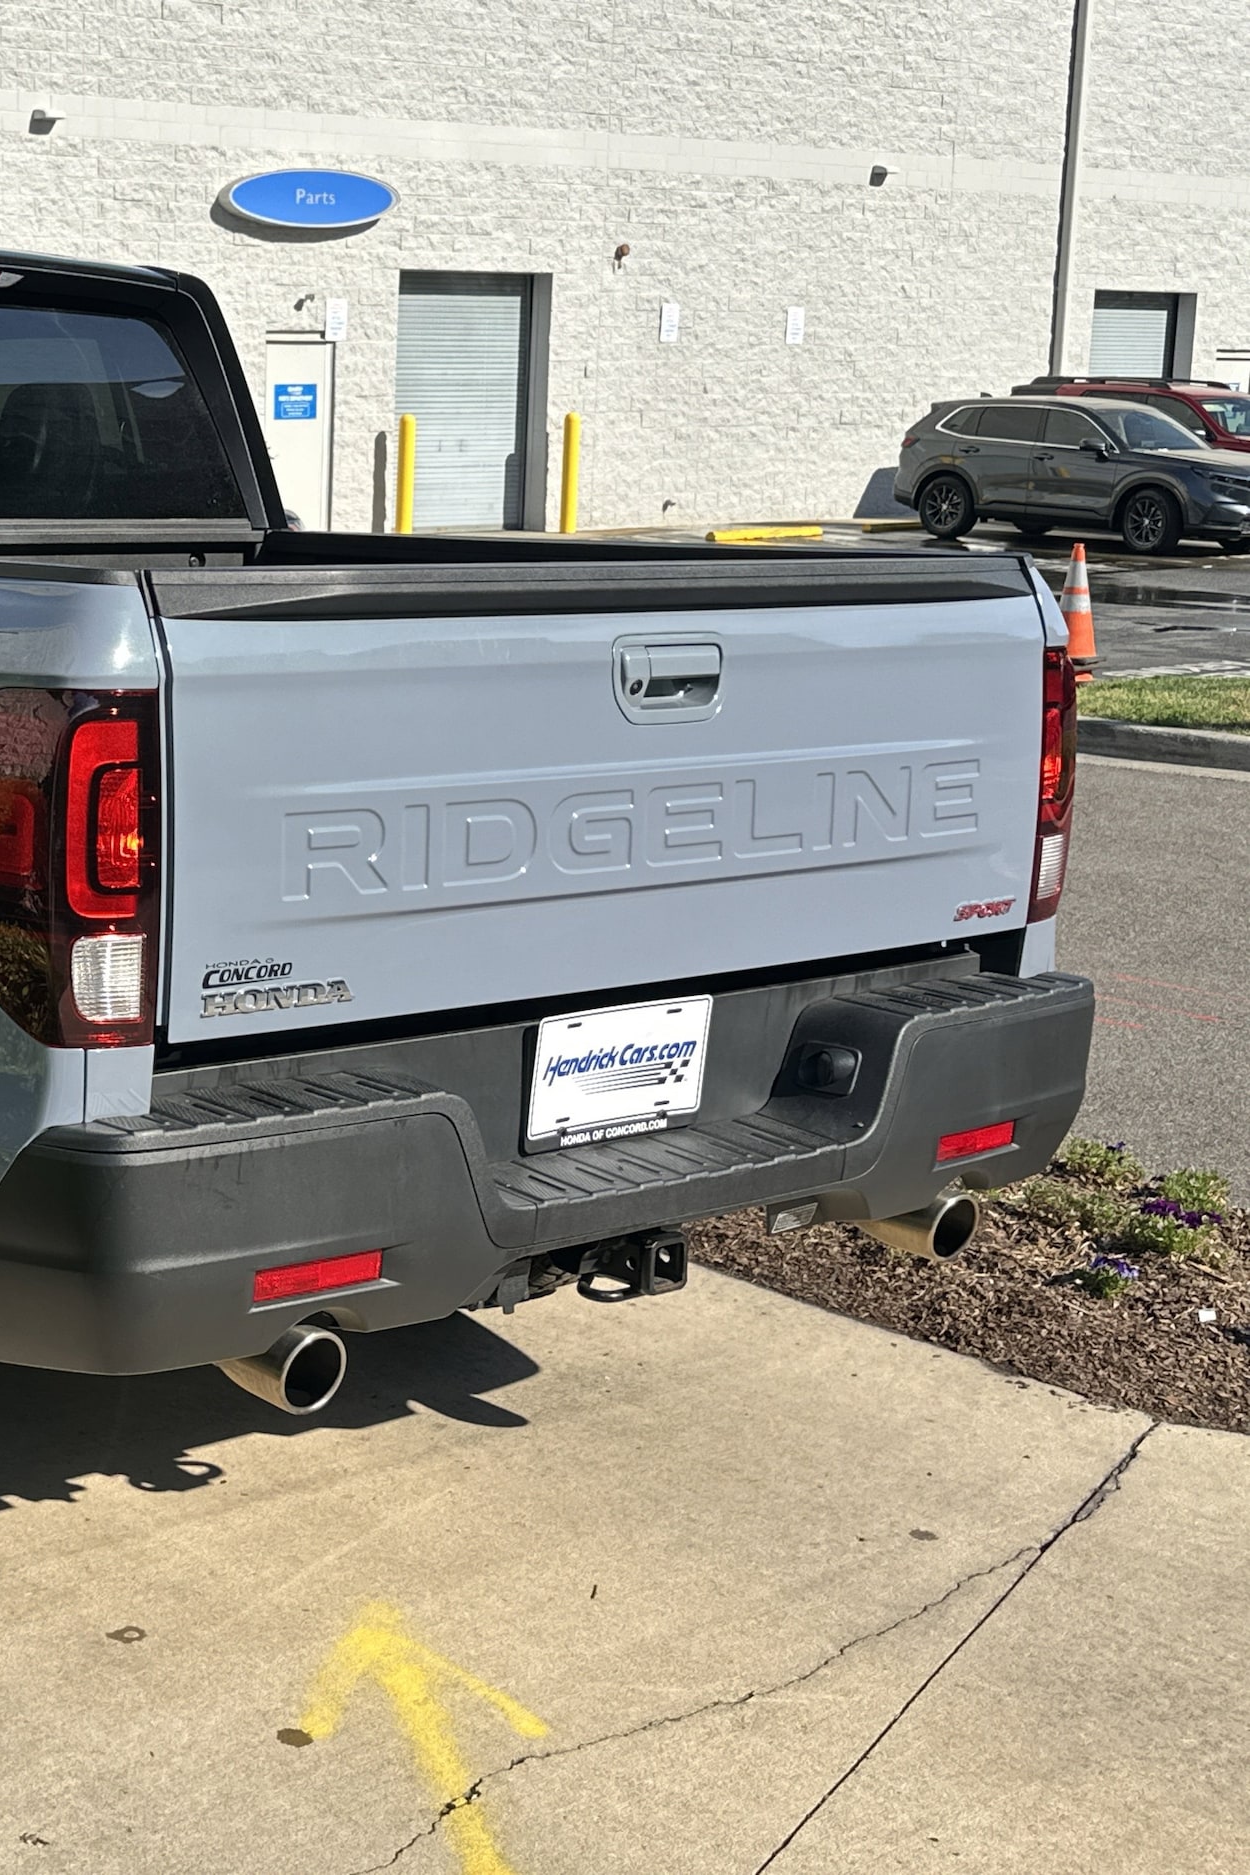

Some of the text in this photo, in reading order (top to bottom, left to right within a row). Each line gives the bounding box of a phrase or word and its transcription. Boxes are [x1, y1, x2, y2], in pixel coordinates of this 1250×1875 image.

[295, 188, 336, 205] Parts
[281, 759, 981, 901] RIDGELINE
[202, 962, 293, 989] CONCORD
[205, 958, 261, 970] HONDA
[200, 978, 355, 1018] HONDA
[560, 1118, 668, 1147] HONDA OF CONCORD.COM
